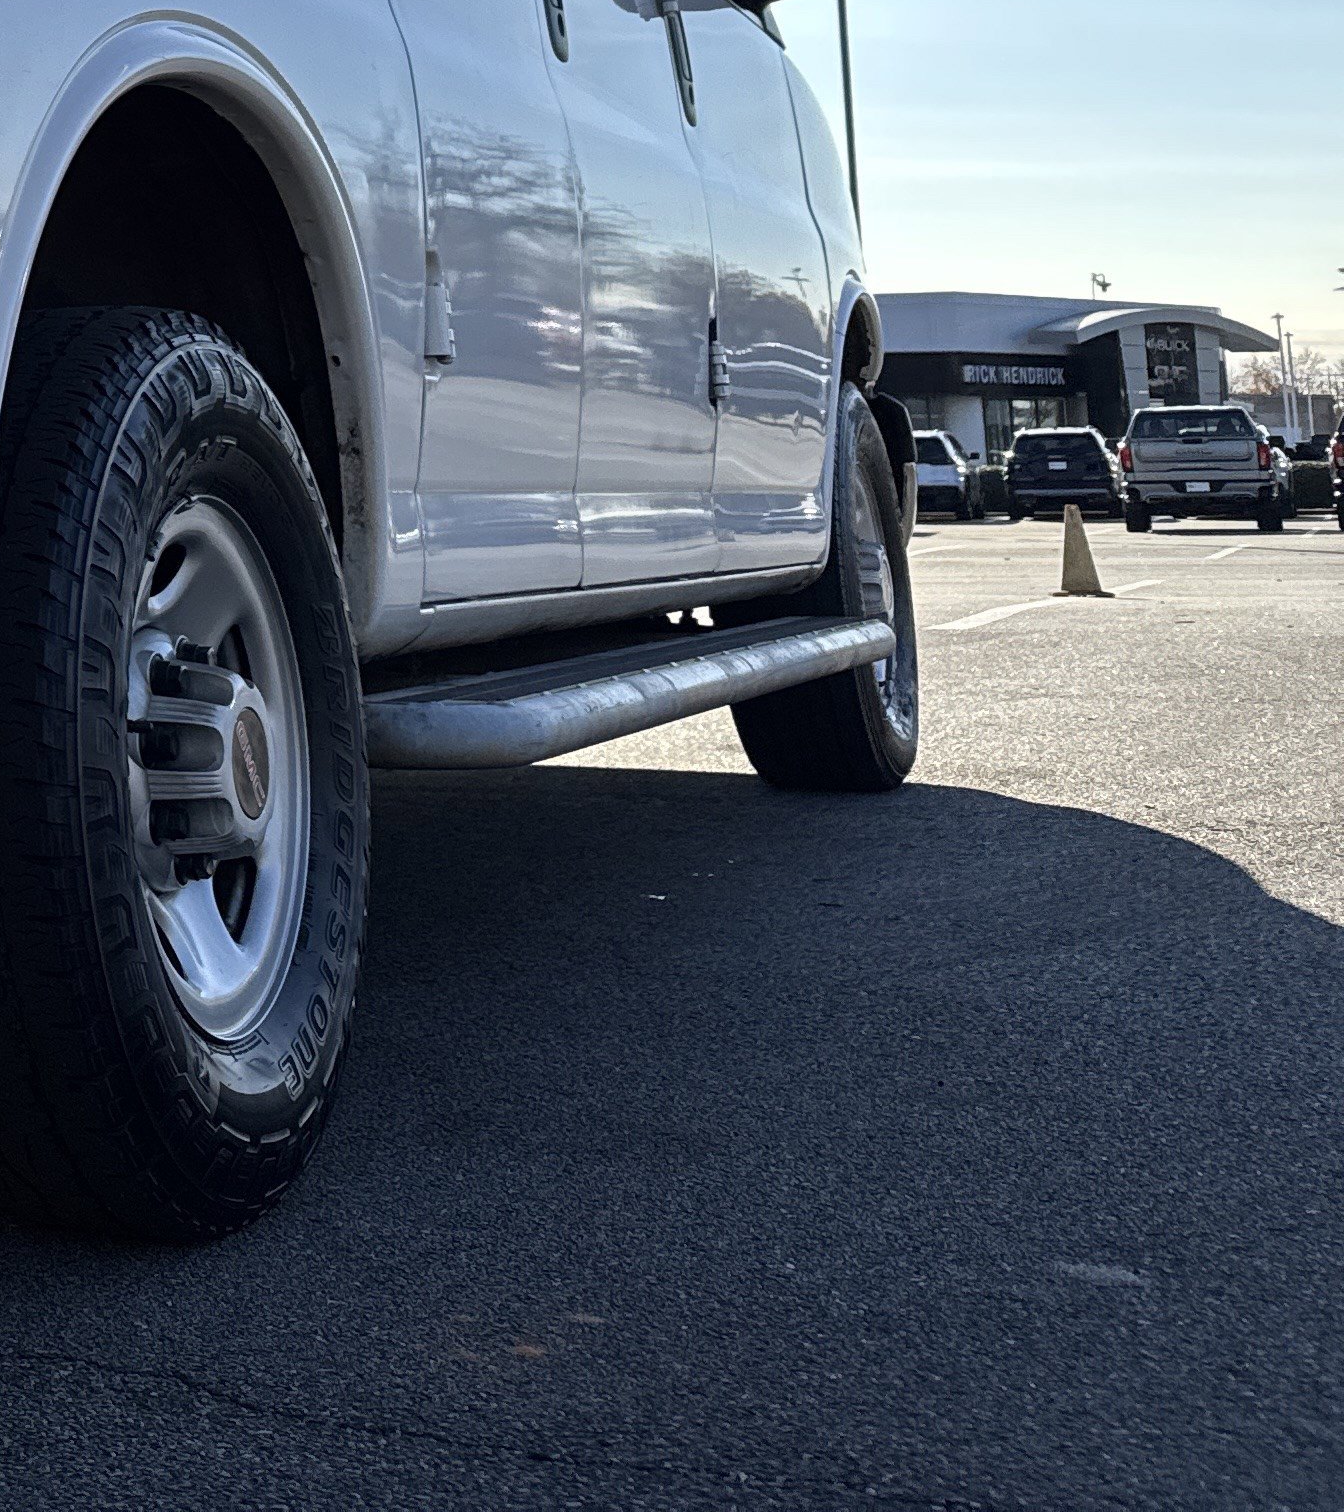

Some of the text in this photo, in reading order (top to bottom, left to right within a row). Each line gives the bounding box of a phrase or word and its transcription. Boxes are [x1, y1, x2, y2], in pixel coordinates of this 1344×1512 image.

[962, 364, 1065, 386] RICK HENDRICK
[236, 720, 266, 807] GMC
[278, 601, 358, 1101] BRIDGESTONE
